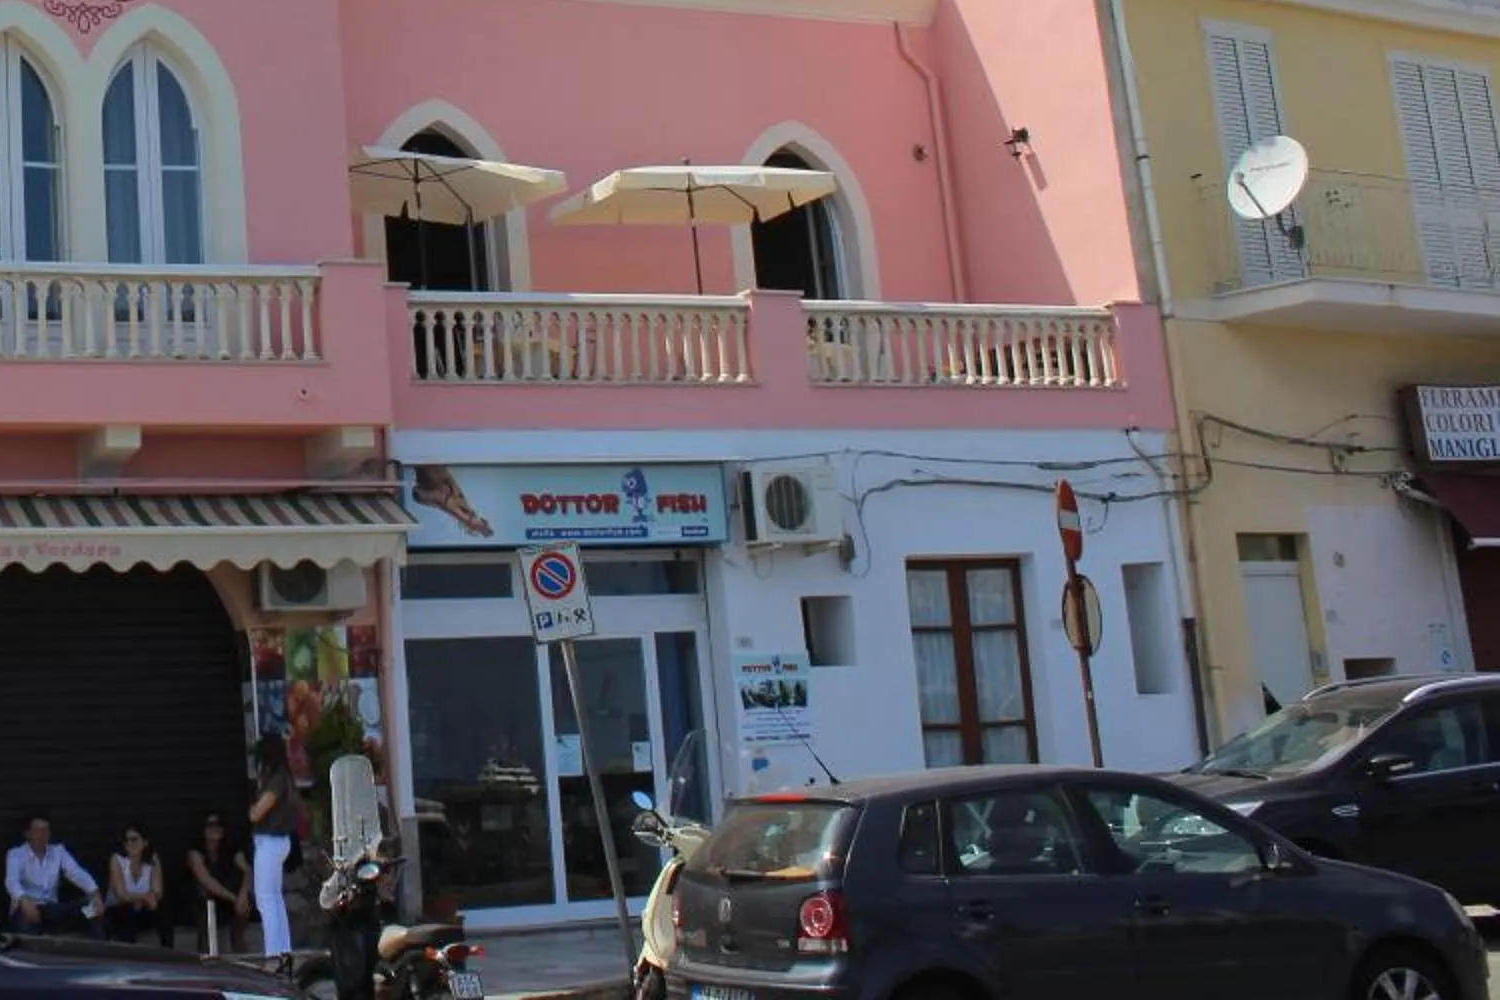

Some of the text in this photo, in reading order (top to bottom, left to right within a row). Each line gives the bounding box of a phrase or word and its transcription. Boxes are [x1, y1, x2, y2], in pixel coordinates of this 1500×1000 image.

[1421, 389, 1500, 408] FERRAM
[1425, 413, 1496, 432] COLORI
[520, 493, 708, 515] DOTTOR FISH
